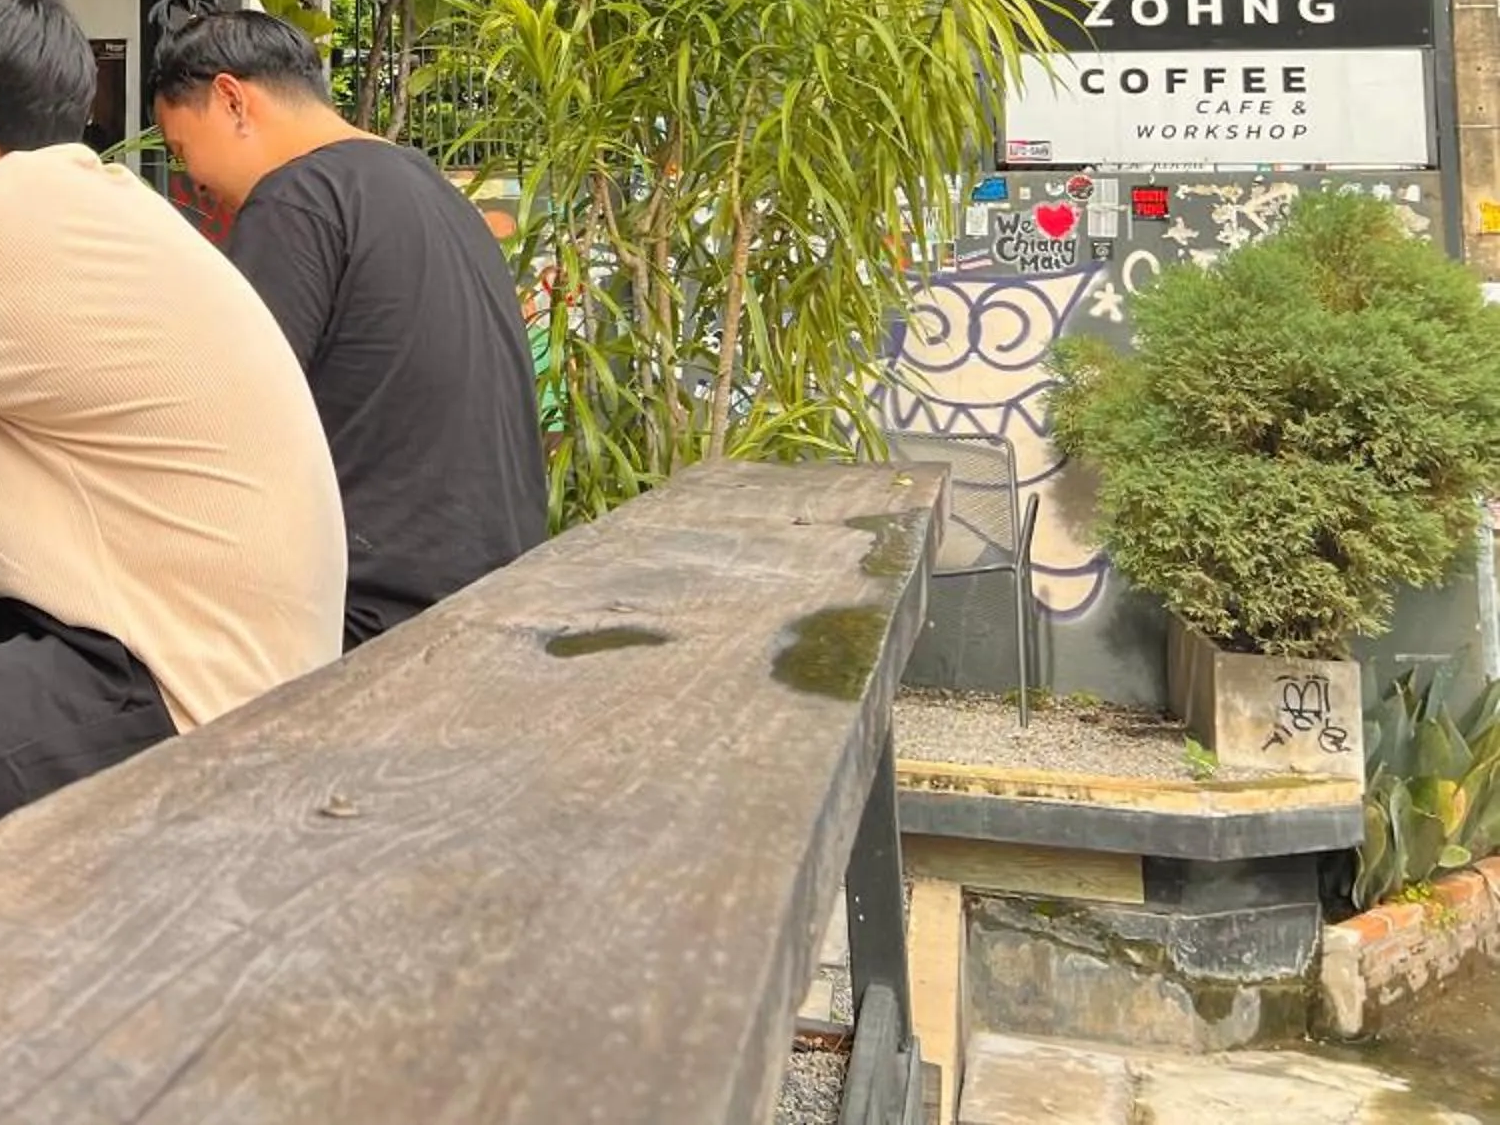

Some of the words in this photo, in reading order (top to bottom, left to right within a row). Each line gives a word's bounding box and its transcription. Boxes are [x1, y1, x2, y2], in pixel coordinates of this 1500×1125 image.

[1079, 66, 1308, 94] COFFEE
[1195, 99, 1274, 116] CAFE
[1292, 100, 1308, 116] &
[1136, 123, 1309, 140] WORKSHOP
[997, 213, 1033, 235] We
[995, 232, 1077, 266] Chiang
[1020, 254, 1062, 272] Mai
